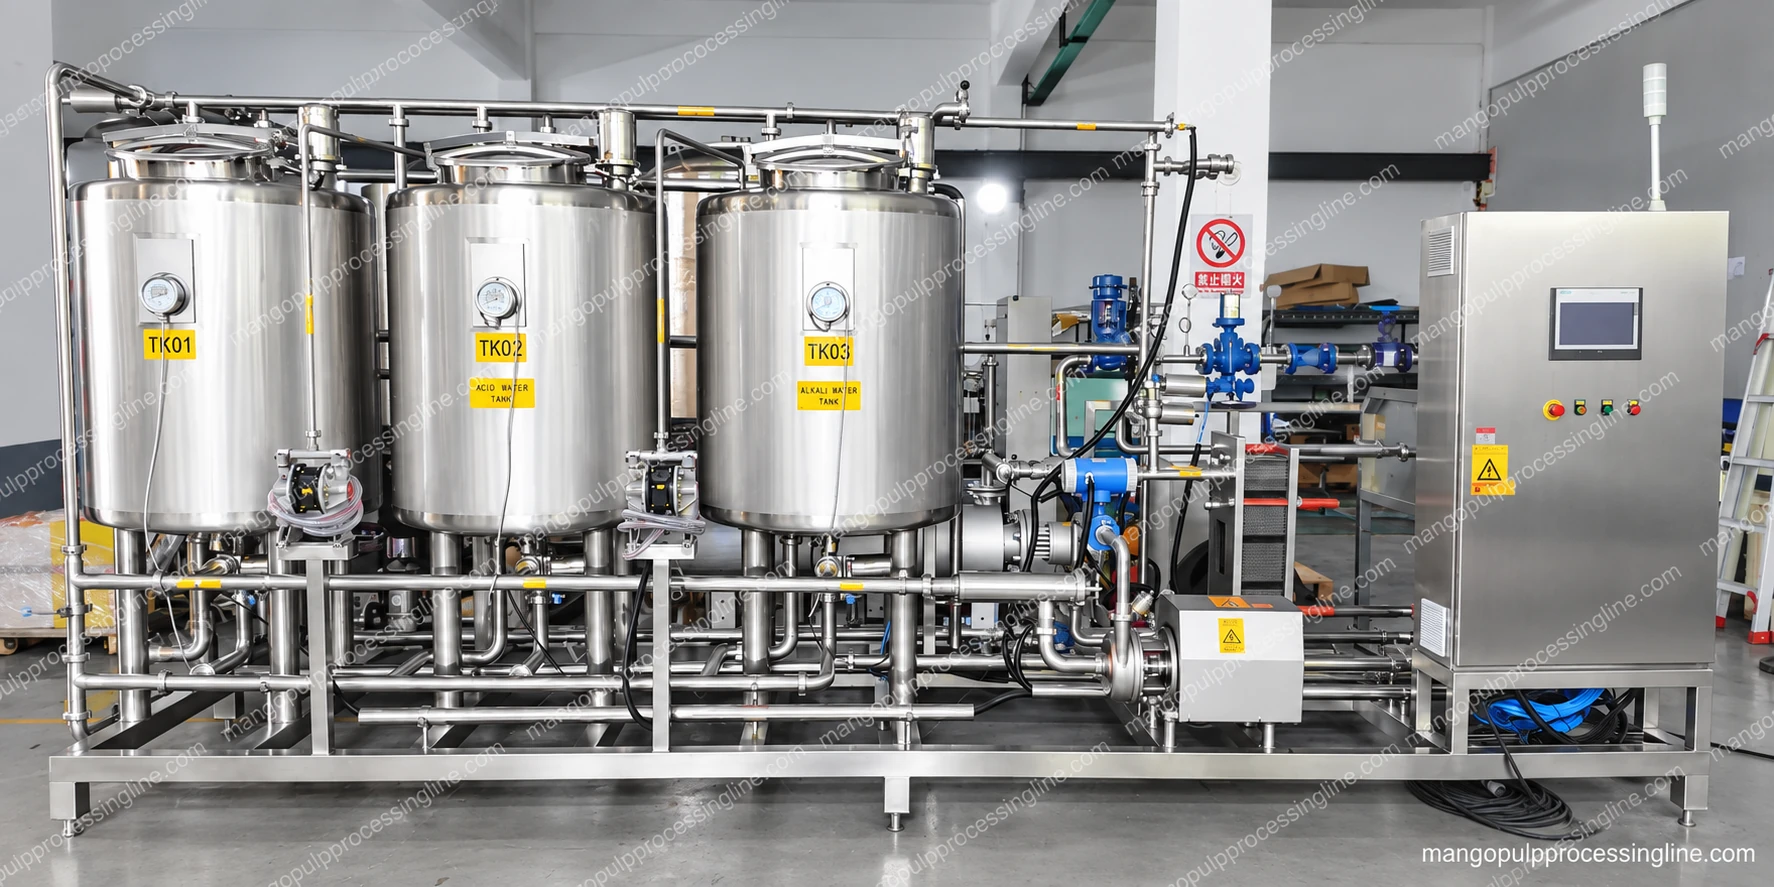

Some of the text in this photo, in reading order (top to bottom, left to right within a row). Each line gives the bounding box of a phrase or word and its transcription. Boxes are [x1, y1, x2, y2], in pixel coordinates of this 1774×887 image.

[148, 336, 190, 353] TK01
[479, 339, 523, 357] TK02
[807, 343, 850, 360] TK03
